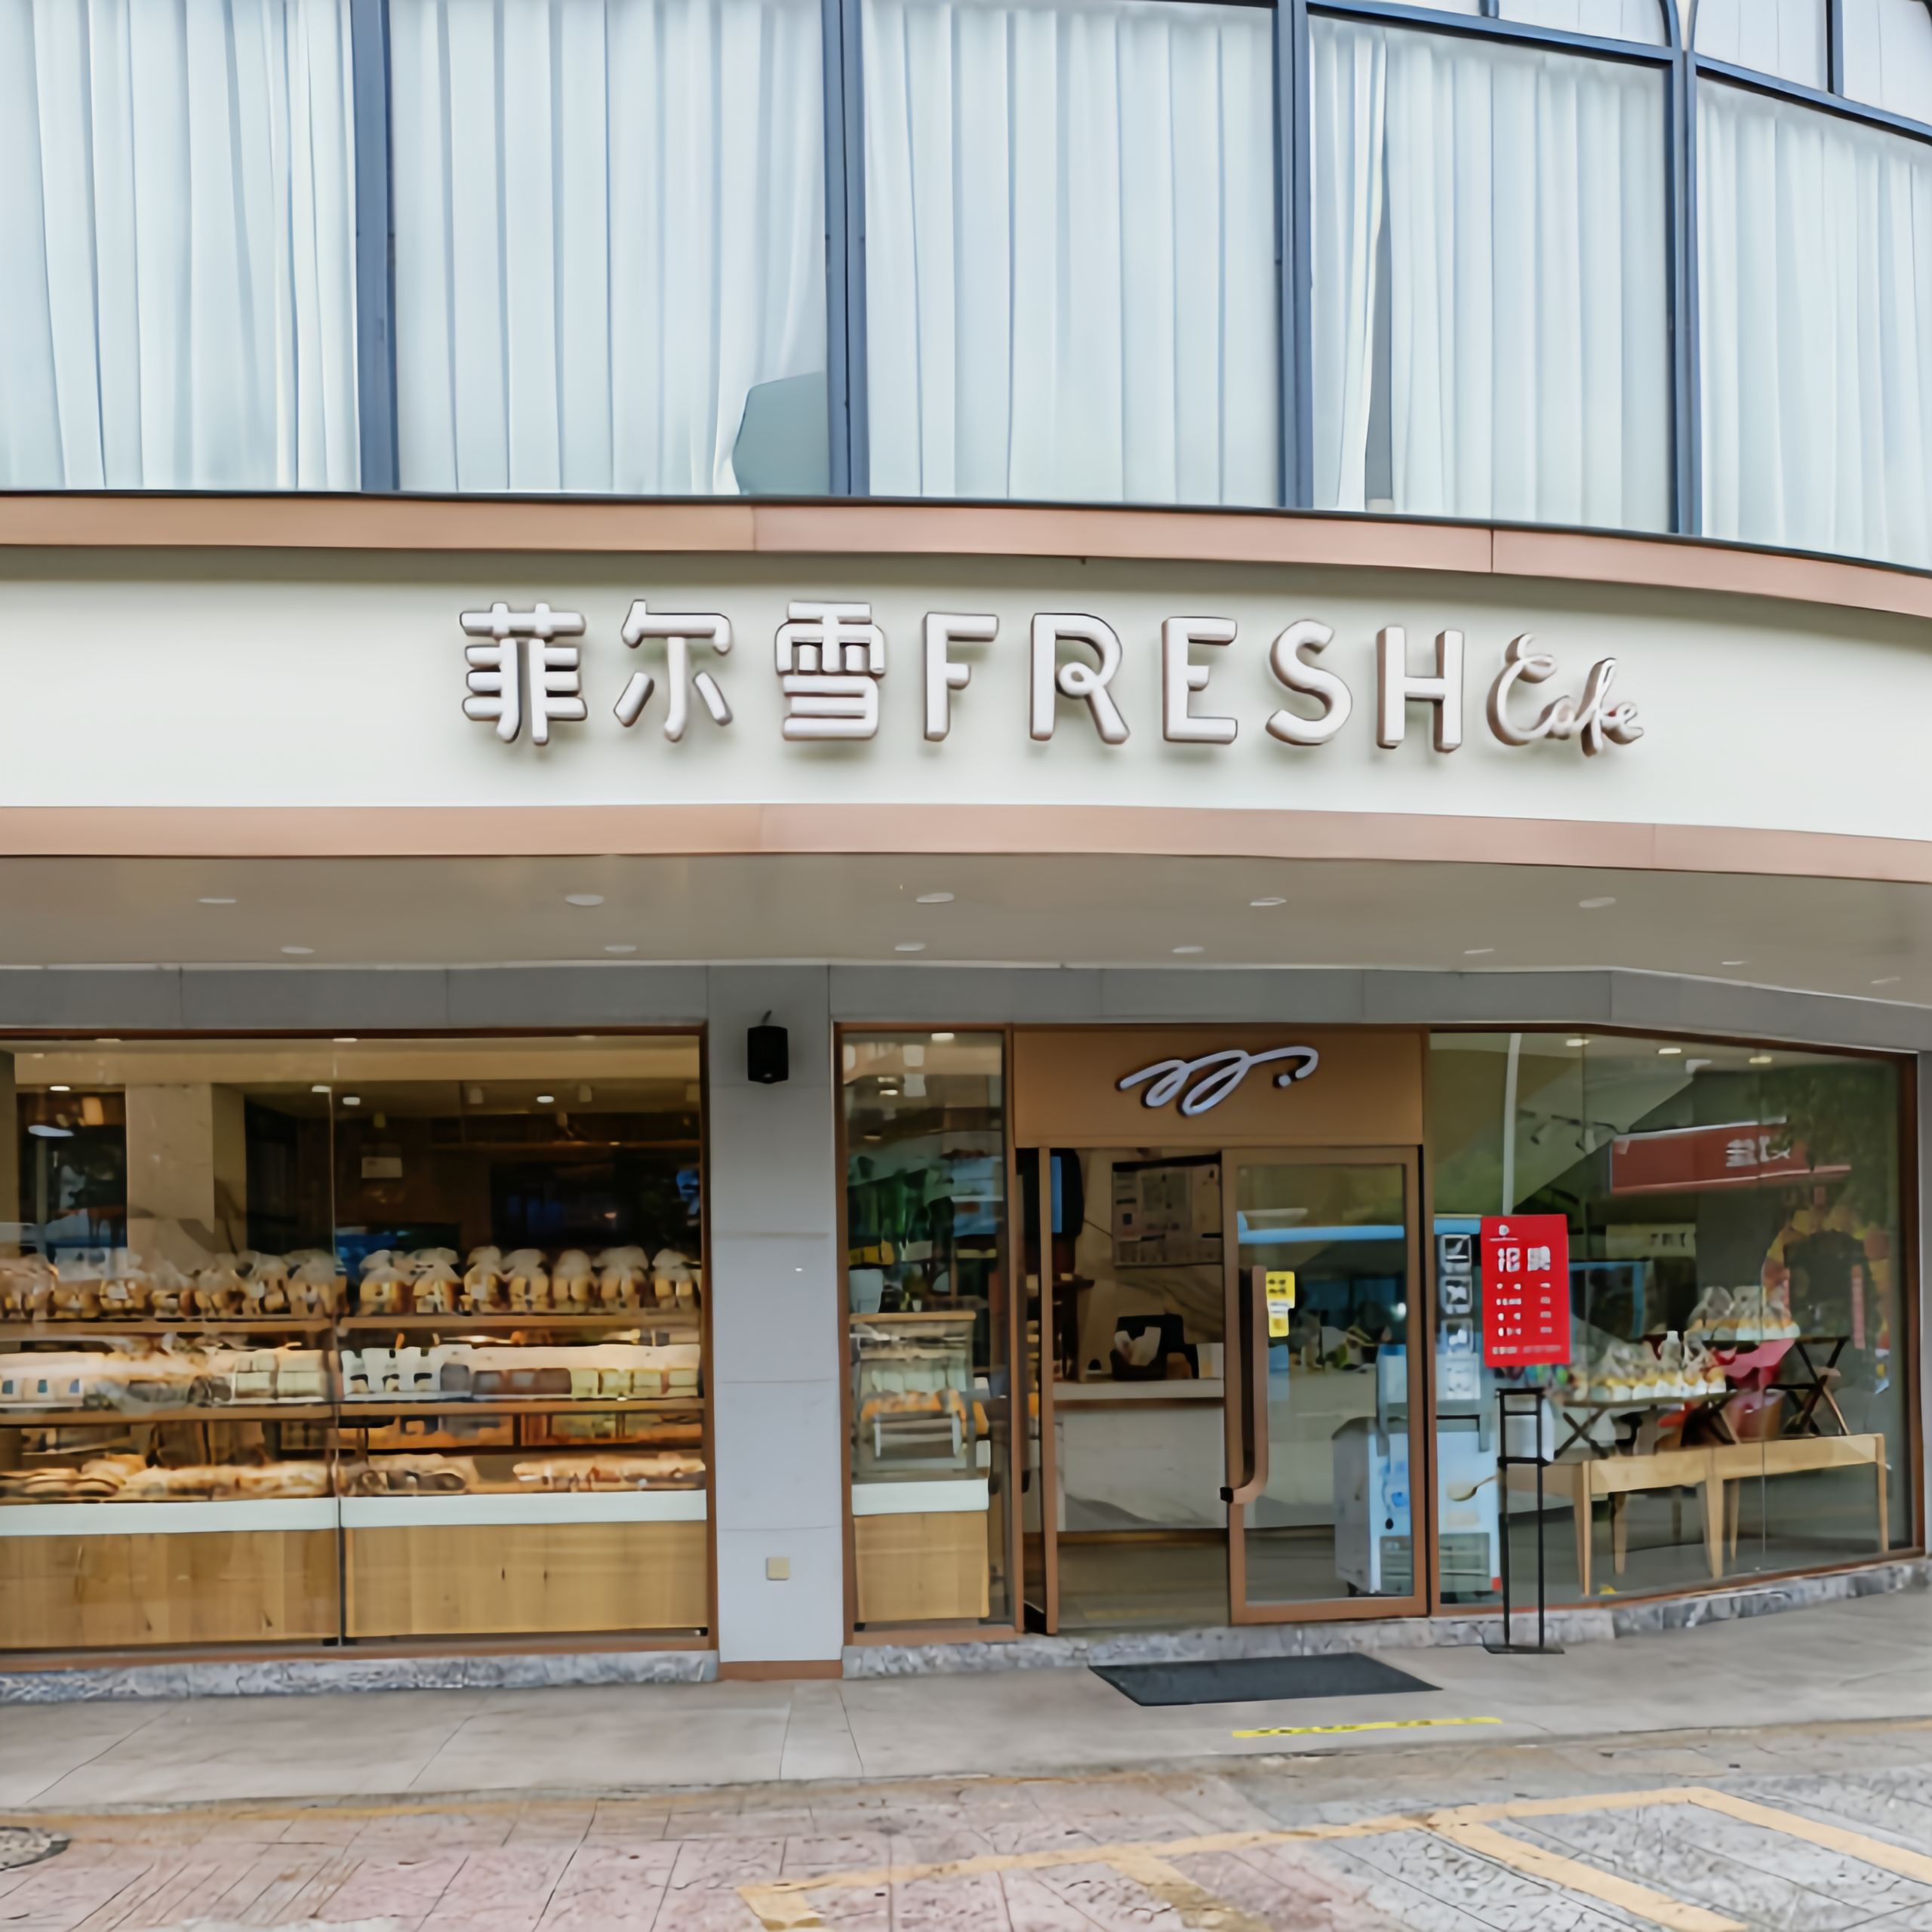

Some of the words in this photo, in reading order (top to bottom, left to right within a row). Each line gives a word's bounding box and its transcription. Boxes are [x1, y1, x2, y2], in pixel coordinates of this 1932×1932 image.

[459, 599, 886, 746] 菲尔雪
[922, 611, 1465, 754] FRESH
[1486, 632, 1645, 758] Cake
